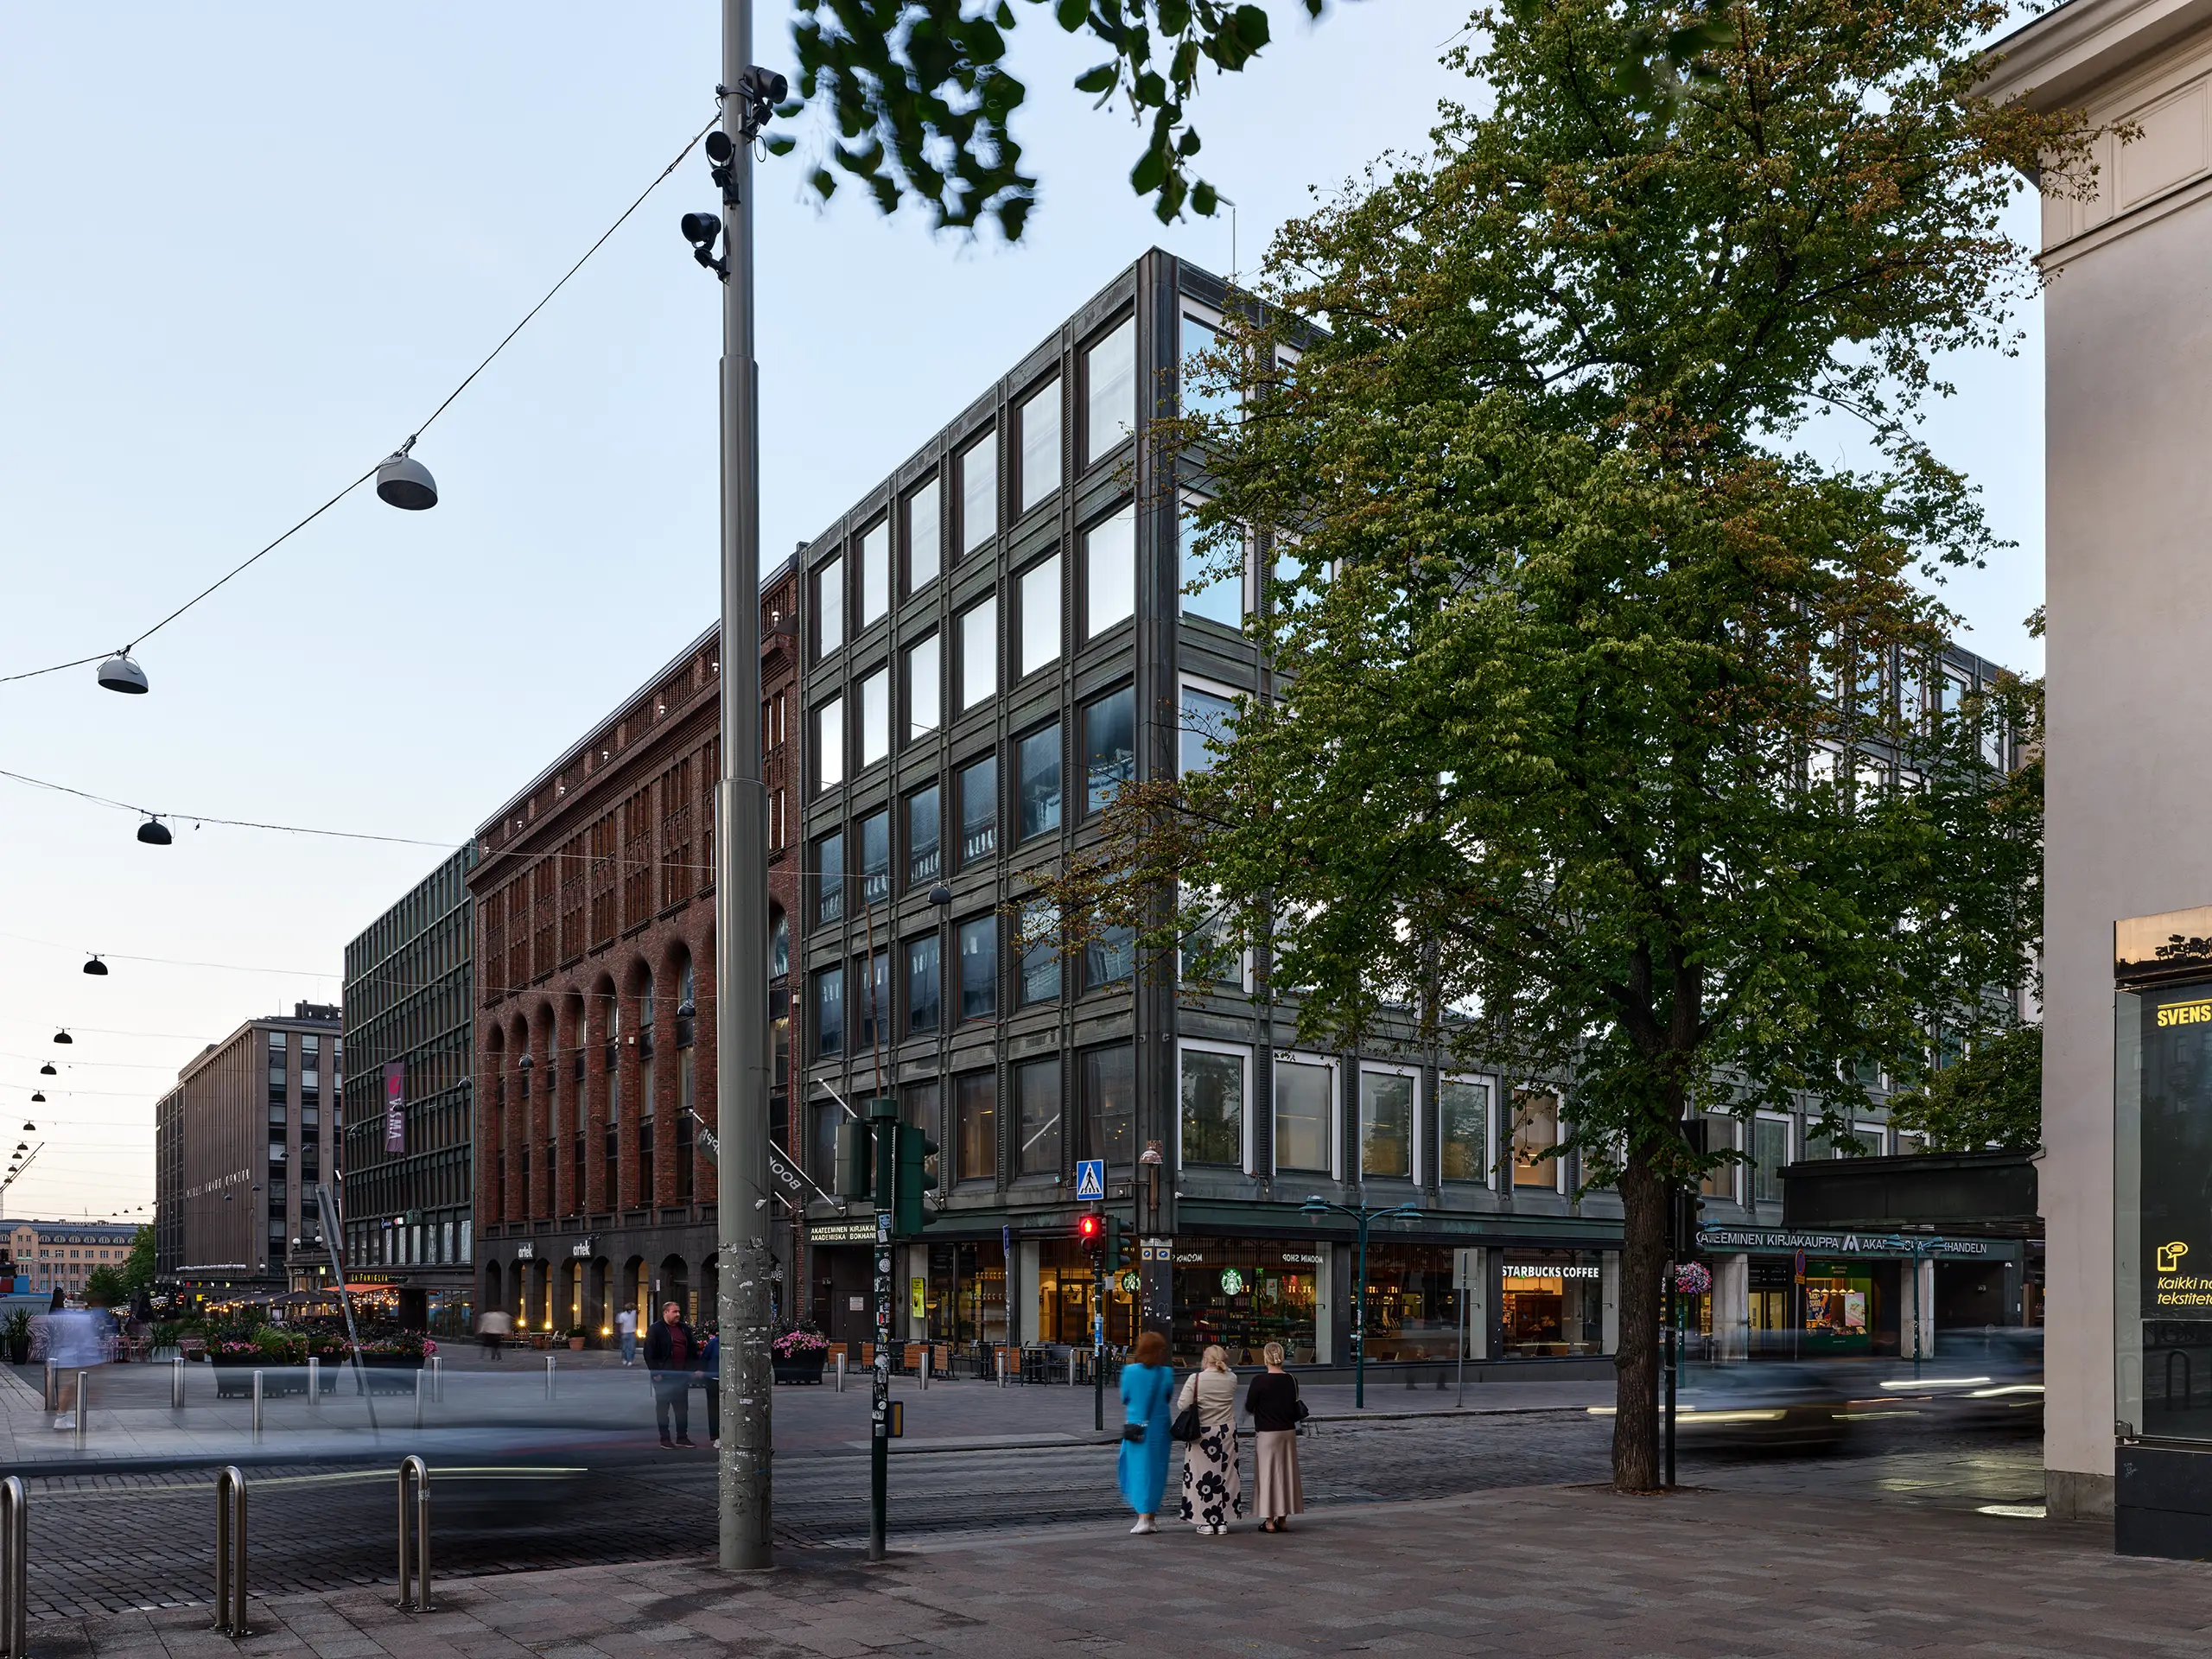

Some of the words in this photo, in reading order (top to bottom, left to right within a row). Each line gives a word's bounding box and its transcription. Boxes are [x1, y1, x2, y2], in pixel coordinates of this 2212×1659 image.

[573, 1239, 590, 1256] artek
[1766, 1234, 1839, 1248] KIRJAKAUPPA
[518, 1243, 533, 1257] artek
[1502, 1265, 1561, 1278] STARBUCKS
[1562, 1267, 1599, 1278] COFFEE
[2157, 1276, 2198, 1289] Kaikki
[2157, 1292, 2212, 1305] tekstitet
